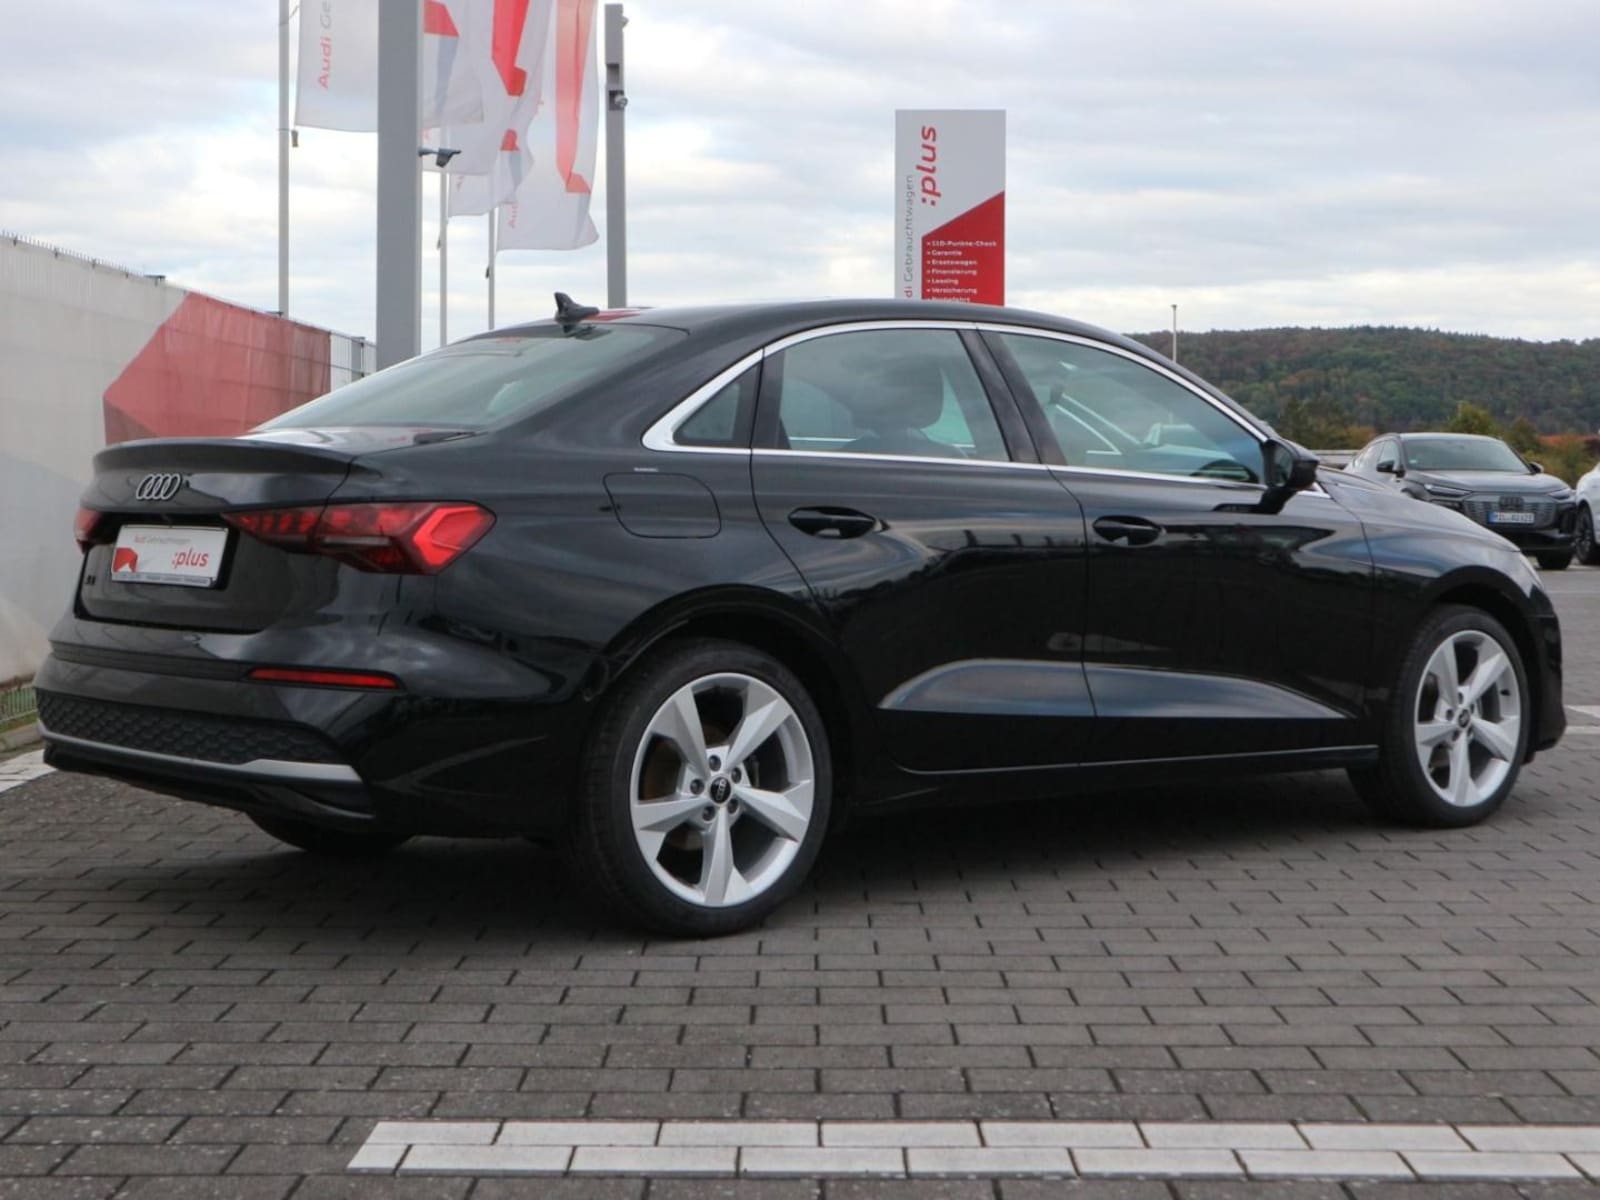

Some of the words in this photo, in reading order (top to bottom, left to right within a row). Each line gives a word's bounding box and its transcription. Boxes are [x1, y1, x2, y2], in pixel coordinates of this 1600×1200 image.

[318, 36, 331, 90] Audi
[904, 175, 915, 282] Gebrauchtwagen
[932, 259, 977, 267] Ersatzwagen
